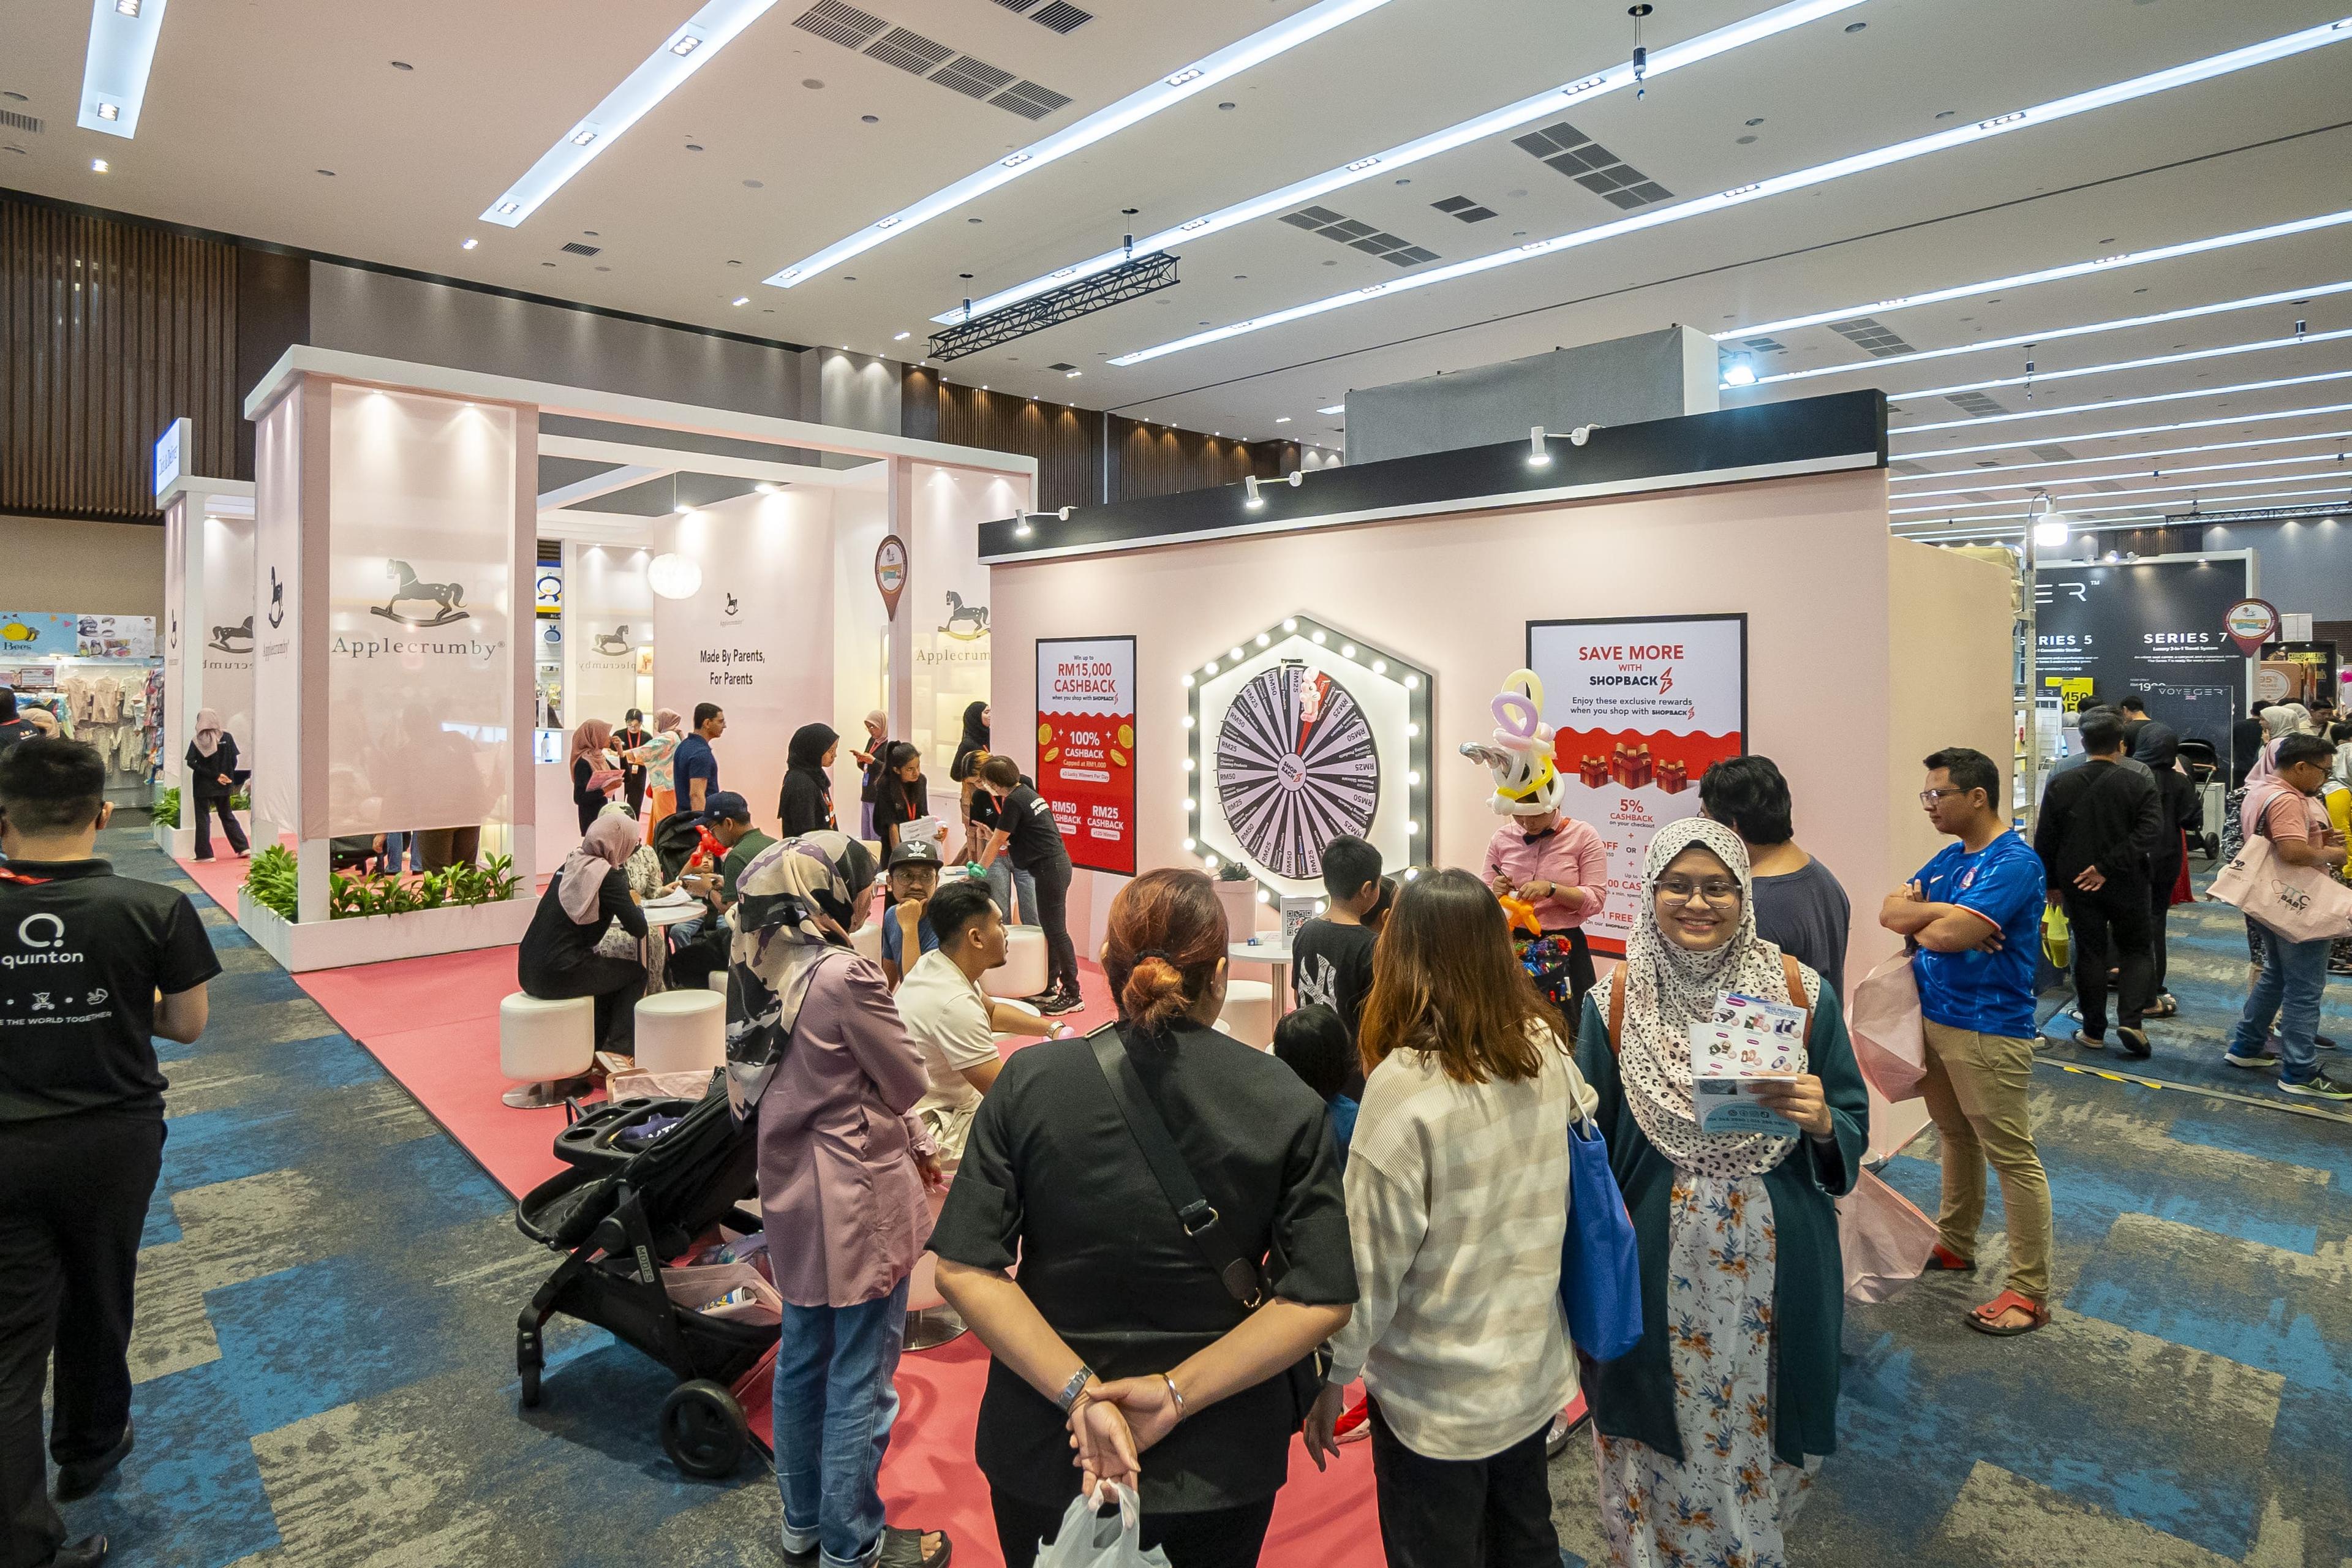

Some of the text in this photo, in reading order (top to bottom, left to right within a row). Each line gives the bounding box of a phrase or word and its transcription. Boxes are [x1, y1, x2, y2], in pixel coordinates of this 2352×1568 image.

[2020, 635, 2093, 646] SRIES 5
[2144, 633, 2228, 644] SERIES 7
[700, 649, 766, 666] Made By Parents,
[1578, 645, 1684, 661] SAVE MORE
[1058, 663, 1112, 678] RM15,000
[710, 672, 753, 685] For Parents
[1267, 673, 1277, 696] RM50
[1589, 676, 1658, 686] SHOPBACK
[1054, 679, 1116, 693] CASHBACK
[1245, 688, 1258, 709] RM25
[1572, 697, 1593, 706] Enjoy
[1332, 697, 1349, 718] RM25
[1229, 710, 1245, 728] RM50
[1070, 731, 1100, 746] 100%
[1346, 726, 1365, 742] RM50
[1065, 748, 1104, 758] CASHBACK
[1221, 740, 1237, 752] RM25
[1281, 766, 1295, 780] BACK
[1283, 761, 1297, 774] SHOP
[1226, 798, 1243, 812] RM25
[1352, 793, 1373, 807] RM50
[1620, 799, 1643, 813] 5%
[1052, 801, 1077, 814] RM50
[1093, 805, 1118, 819] RM25
[1052, 813, 1082, 824] ASHBACK
[1087, 818, 1124, 830] CASHBACK
[1610, 813, 1653, 822] CASHBACK
[1240, 822, 1254, 842] RM50
[1261, 840, 1272, 863] RM25
[1307, 849, 1318, 873] RM25
[2281, 895, 2305, 911] BABY
[1609, 912, 1633, 922] FREE
[1, 952, 83, 969] quinton
[66, 1011, 112, 1023] TOGETHER
[637, 1247, 652, 1281] MODES
